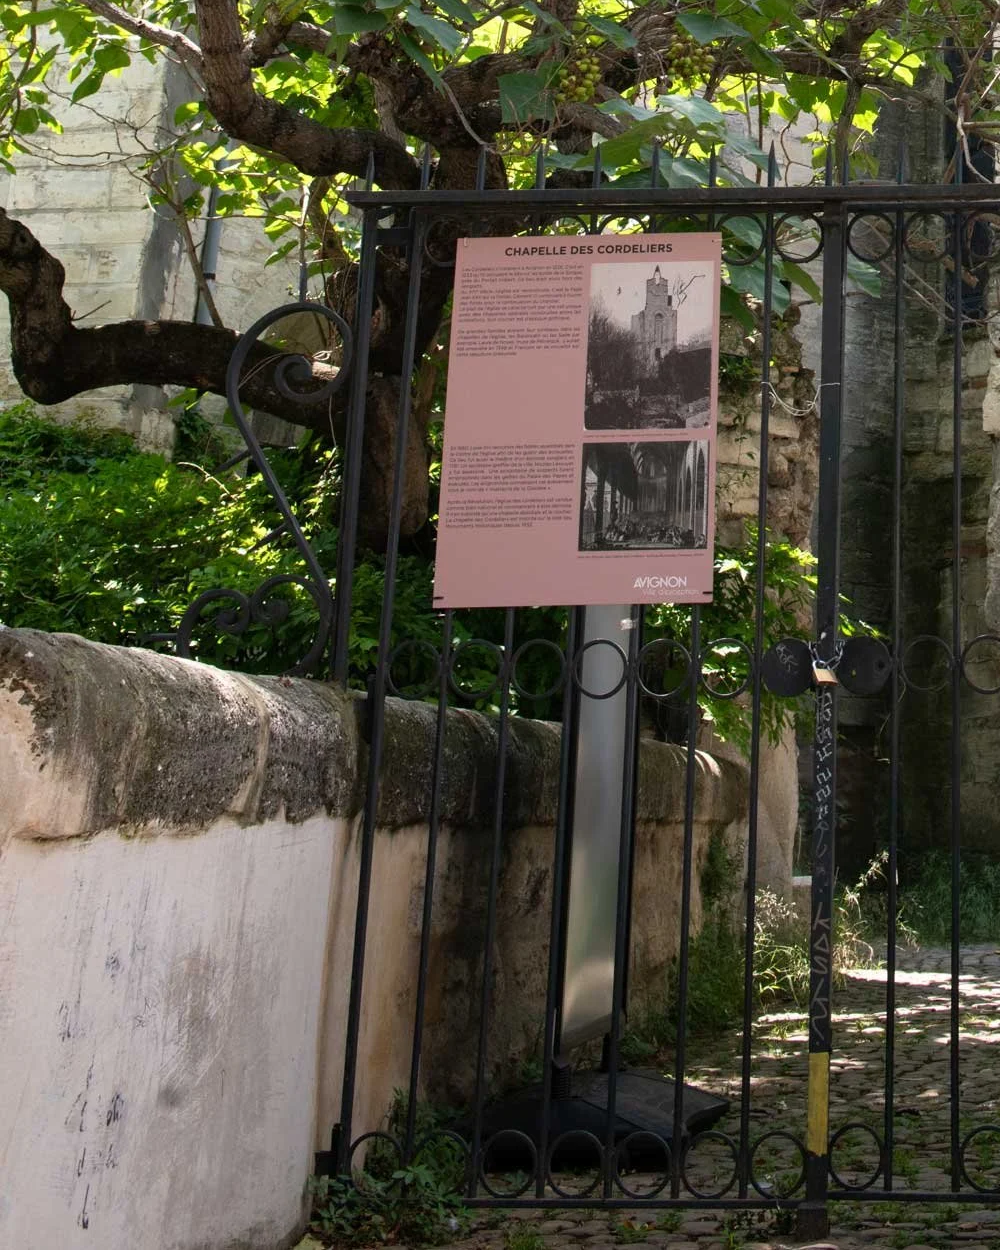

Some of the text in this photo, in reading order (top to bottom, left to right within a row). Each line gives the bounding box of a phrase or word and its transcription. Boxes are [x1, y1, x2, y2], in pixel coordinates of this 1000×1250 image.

[504, 243, 673, 256] CHAPELLE DES CORDELIERS
[633, 575, 688, 588] AVIGNON
